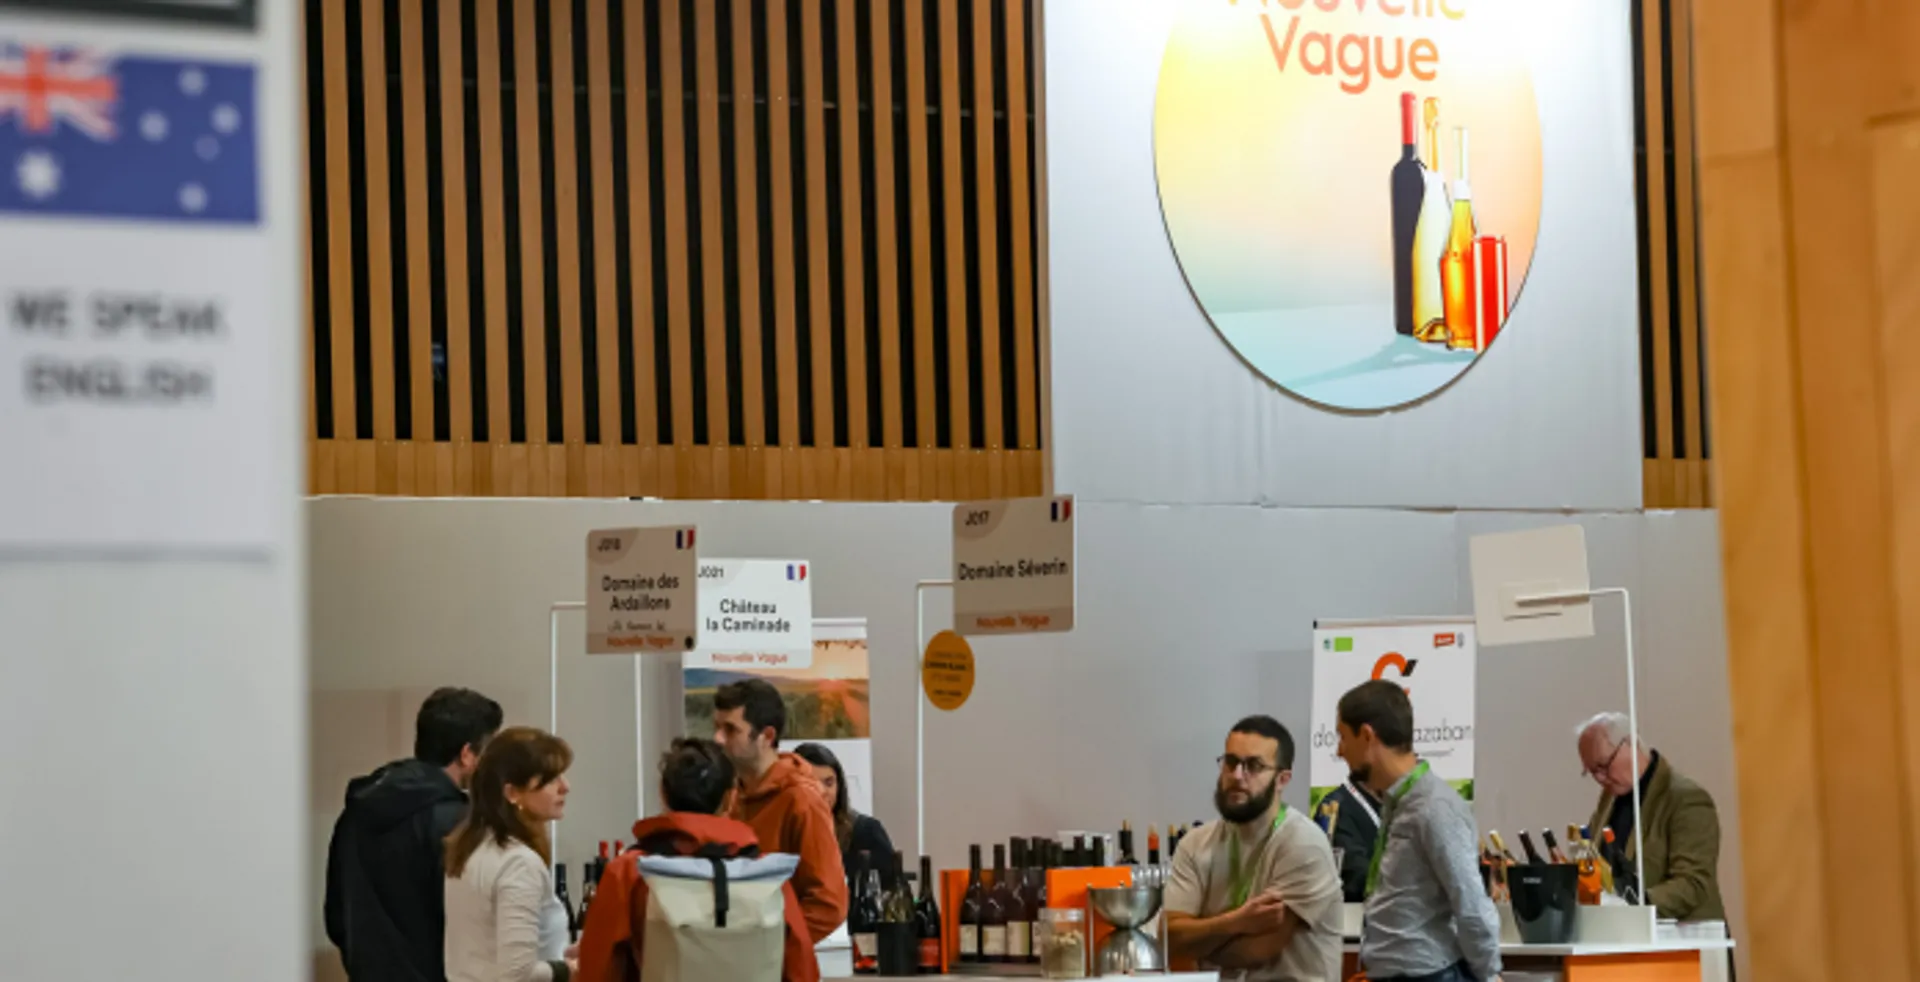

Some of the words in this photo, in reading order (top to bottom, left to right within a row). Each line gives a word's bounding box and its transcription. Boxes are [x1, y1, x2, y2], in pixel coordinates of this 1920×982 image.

[1260, 13, 1440, 95] Vague
[959, 561, 1015, 580] Domaine
[1018, 557, 1068, 578] Séverin
[601, 573, 655, 592] Domaine
[657, 572, 680, 590] des
[609, 594, 671, 612] Ardaillons
[719, 598, 777, 614] Château
[706, 617, 719, 632] la
[722, 617, 791, 633] Caminade
